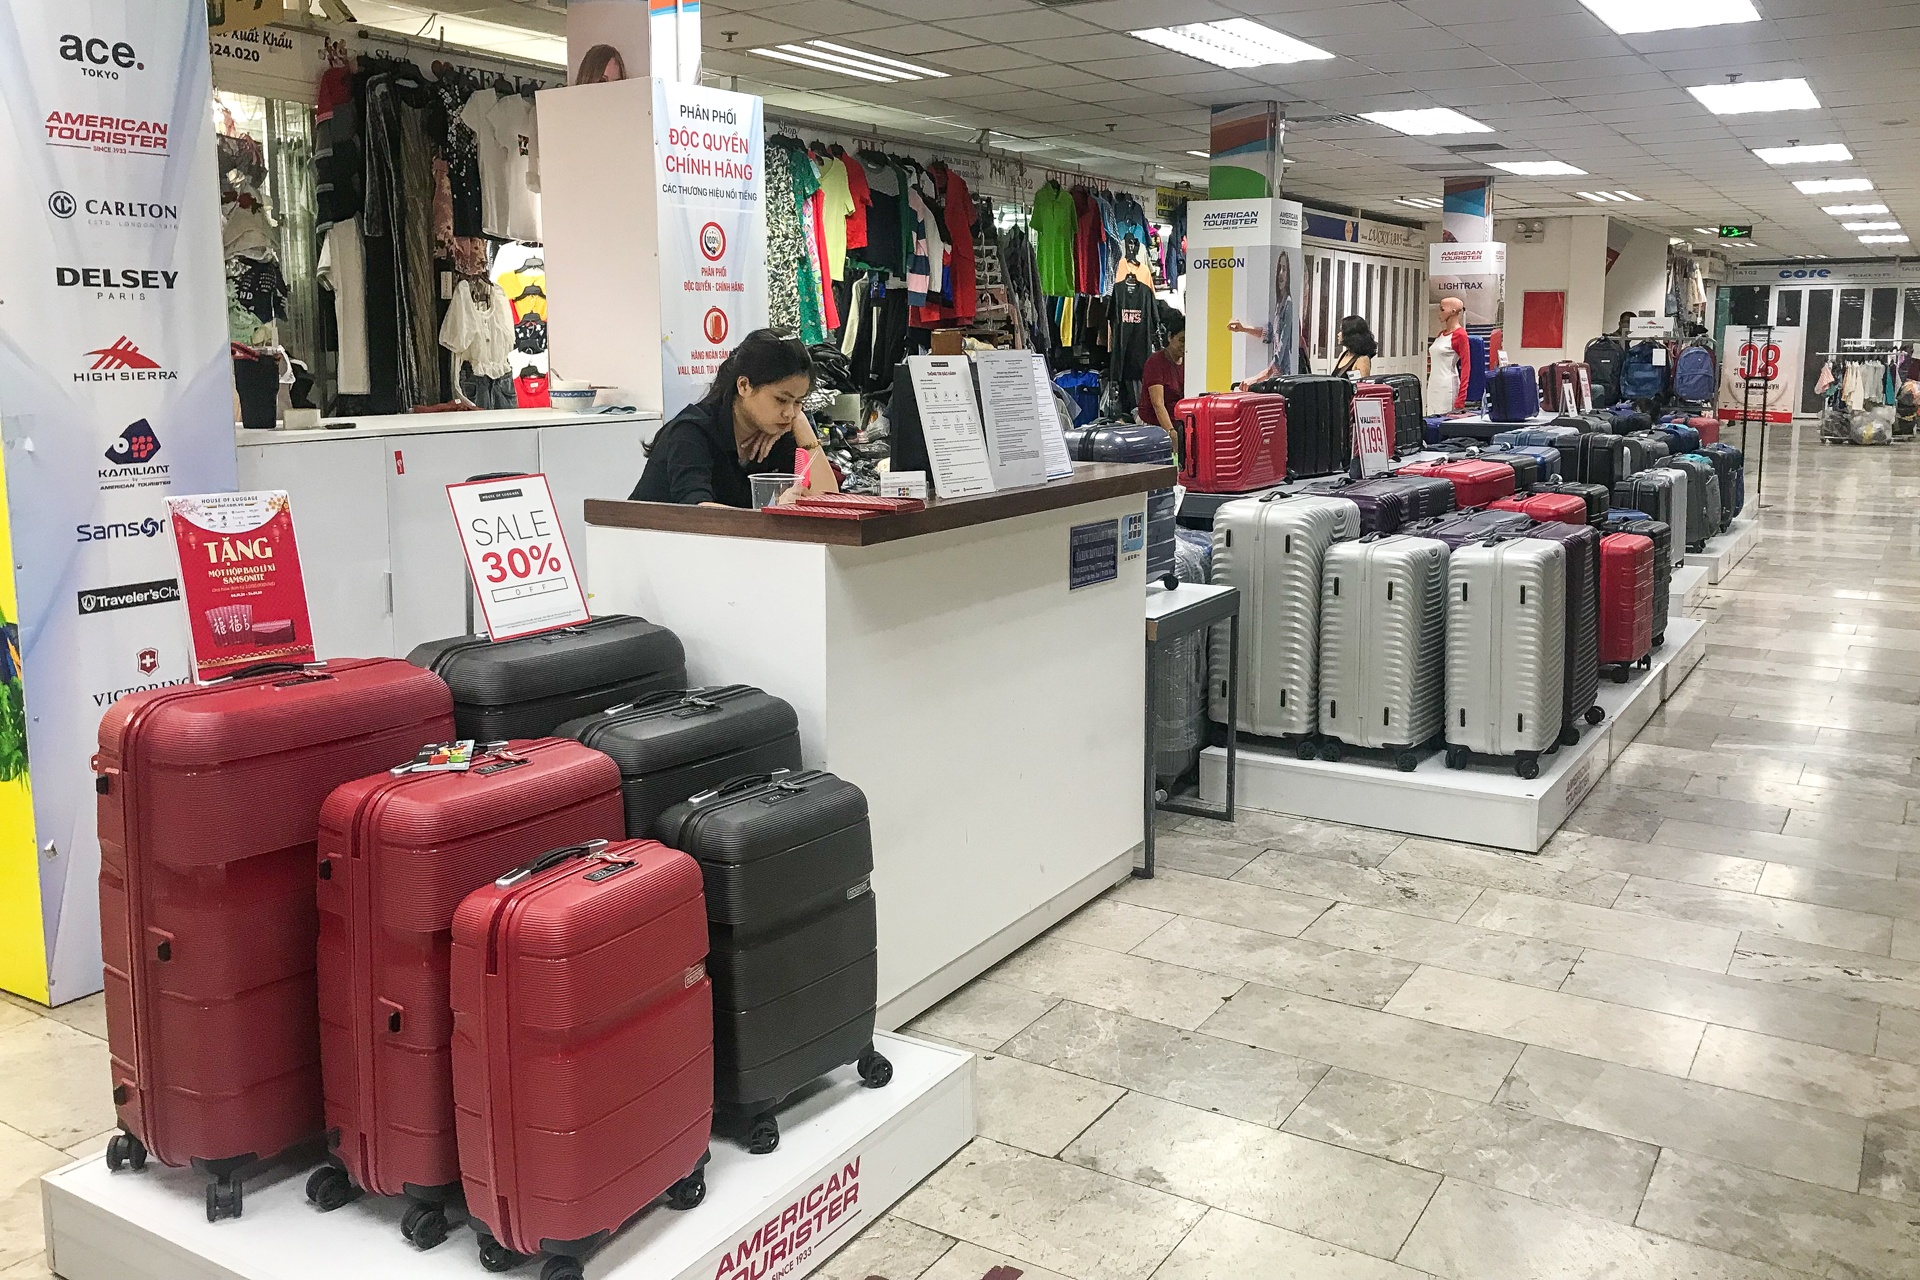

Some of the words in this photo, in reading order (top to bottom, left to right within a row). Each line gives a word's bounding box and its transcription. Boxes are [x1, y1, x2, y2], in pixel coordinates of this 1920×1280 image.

[263, 31, 293, 49] Khẩu
[59, 34, 145, 71] ace.
[81, 67, 119, 80] TOKYO
[46, 111, 168, 135] AMERICAN
[680, 104, 710, 121] PHÂN
[712, 108, 737, 125] PHỐI
[45, 125, 167, 149] TOURISTER
[669, 126, 699, 151] ĐỘC
[703, 131, 749, 154] QUYỀN
[666, 153, 711, 177] CHÍNH
[715, 158, 753, 181] HÃNG
[662, 183, 677, 194] CÁC
[678, 185, 708, 197] THƯƠNG
[709, 188, 725, 200] HIỆU
[738, 189, 758, 201] TIẾNG
[85, 199, 178, 220] CARLTON
[1204, 211, 1259, 220] AMERICAN
[1203, 218, 1257, 227] TOURISTER
[701, 265, 715, 277] PHÂN
[1193, 258, 1245, 270] OREGON
[56, 267, 178, 289] DELSEY
[1779, 269, 1832, 279] core
[1438, 282, 1483, 291] LIGHTRAX
[97, 292, 146, 301] PARIS
[74, 372, 116, 382] HIGH
[120, 371, 178, 381] SIERRA
[98, 465, 170, 478] KAMILIANT
[100, 483, 135, 491] AMERICAN
[472, 510, 551, 547] SALE
[203, 537, 273, 566] TẶNG
[481, 542, 562, 583] 30%
[208, 569, 225, 579] MỘT
[243, 565, 260, 575] BAO
[223, 573, 265, 585] SAMSONITE
[516, 584, 547, 596] OFF
[715, 1155, 861, 1280] AMERICAN
[731, 1182, 859, 1280] OURISTER
[772, 1260, 794, 1280] SINCE
[796, 1246, 812, 1266] 1933
